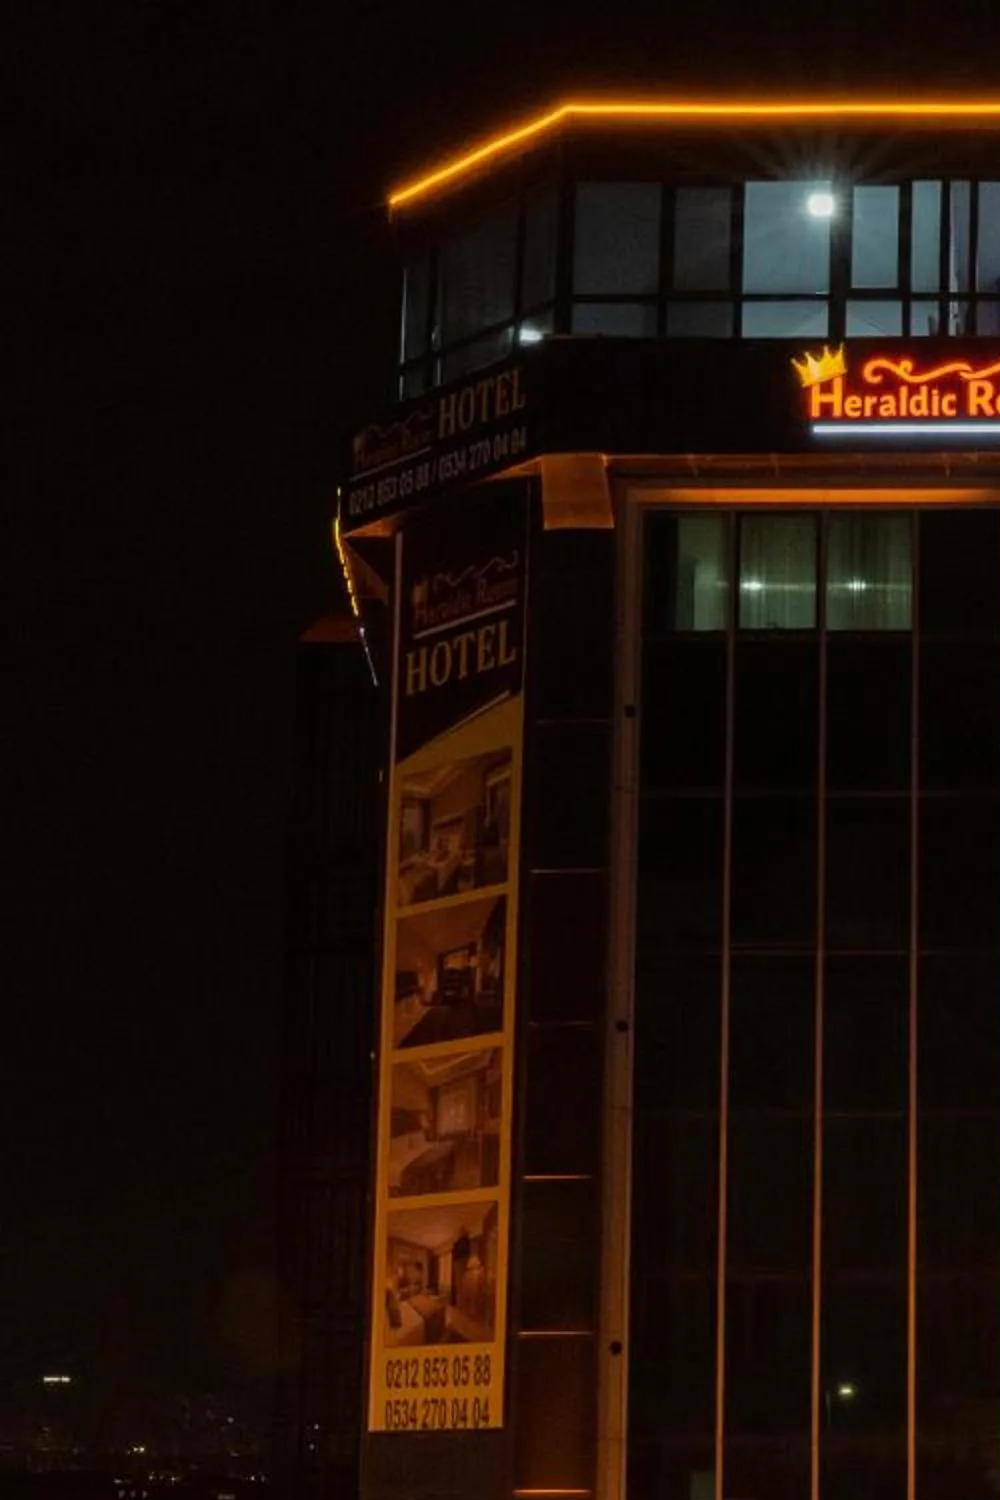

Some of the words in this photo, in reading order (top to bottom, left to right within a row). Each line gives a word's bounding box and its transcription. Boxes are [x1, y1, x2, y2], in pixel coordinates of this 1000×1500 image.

[437, 366, 527, 441] HOTEL
[810, 375, 958, 418] Heraldic
[404, 618, 521, 697] HOTEL
